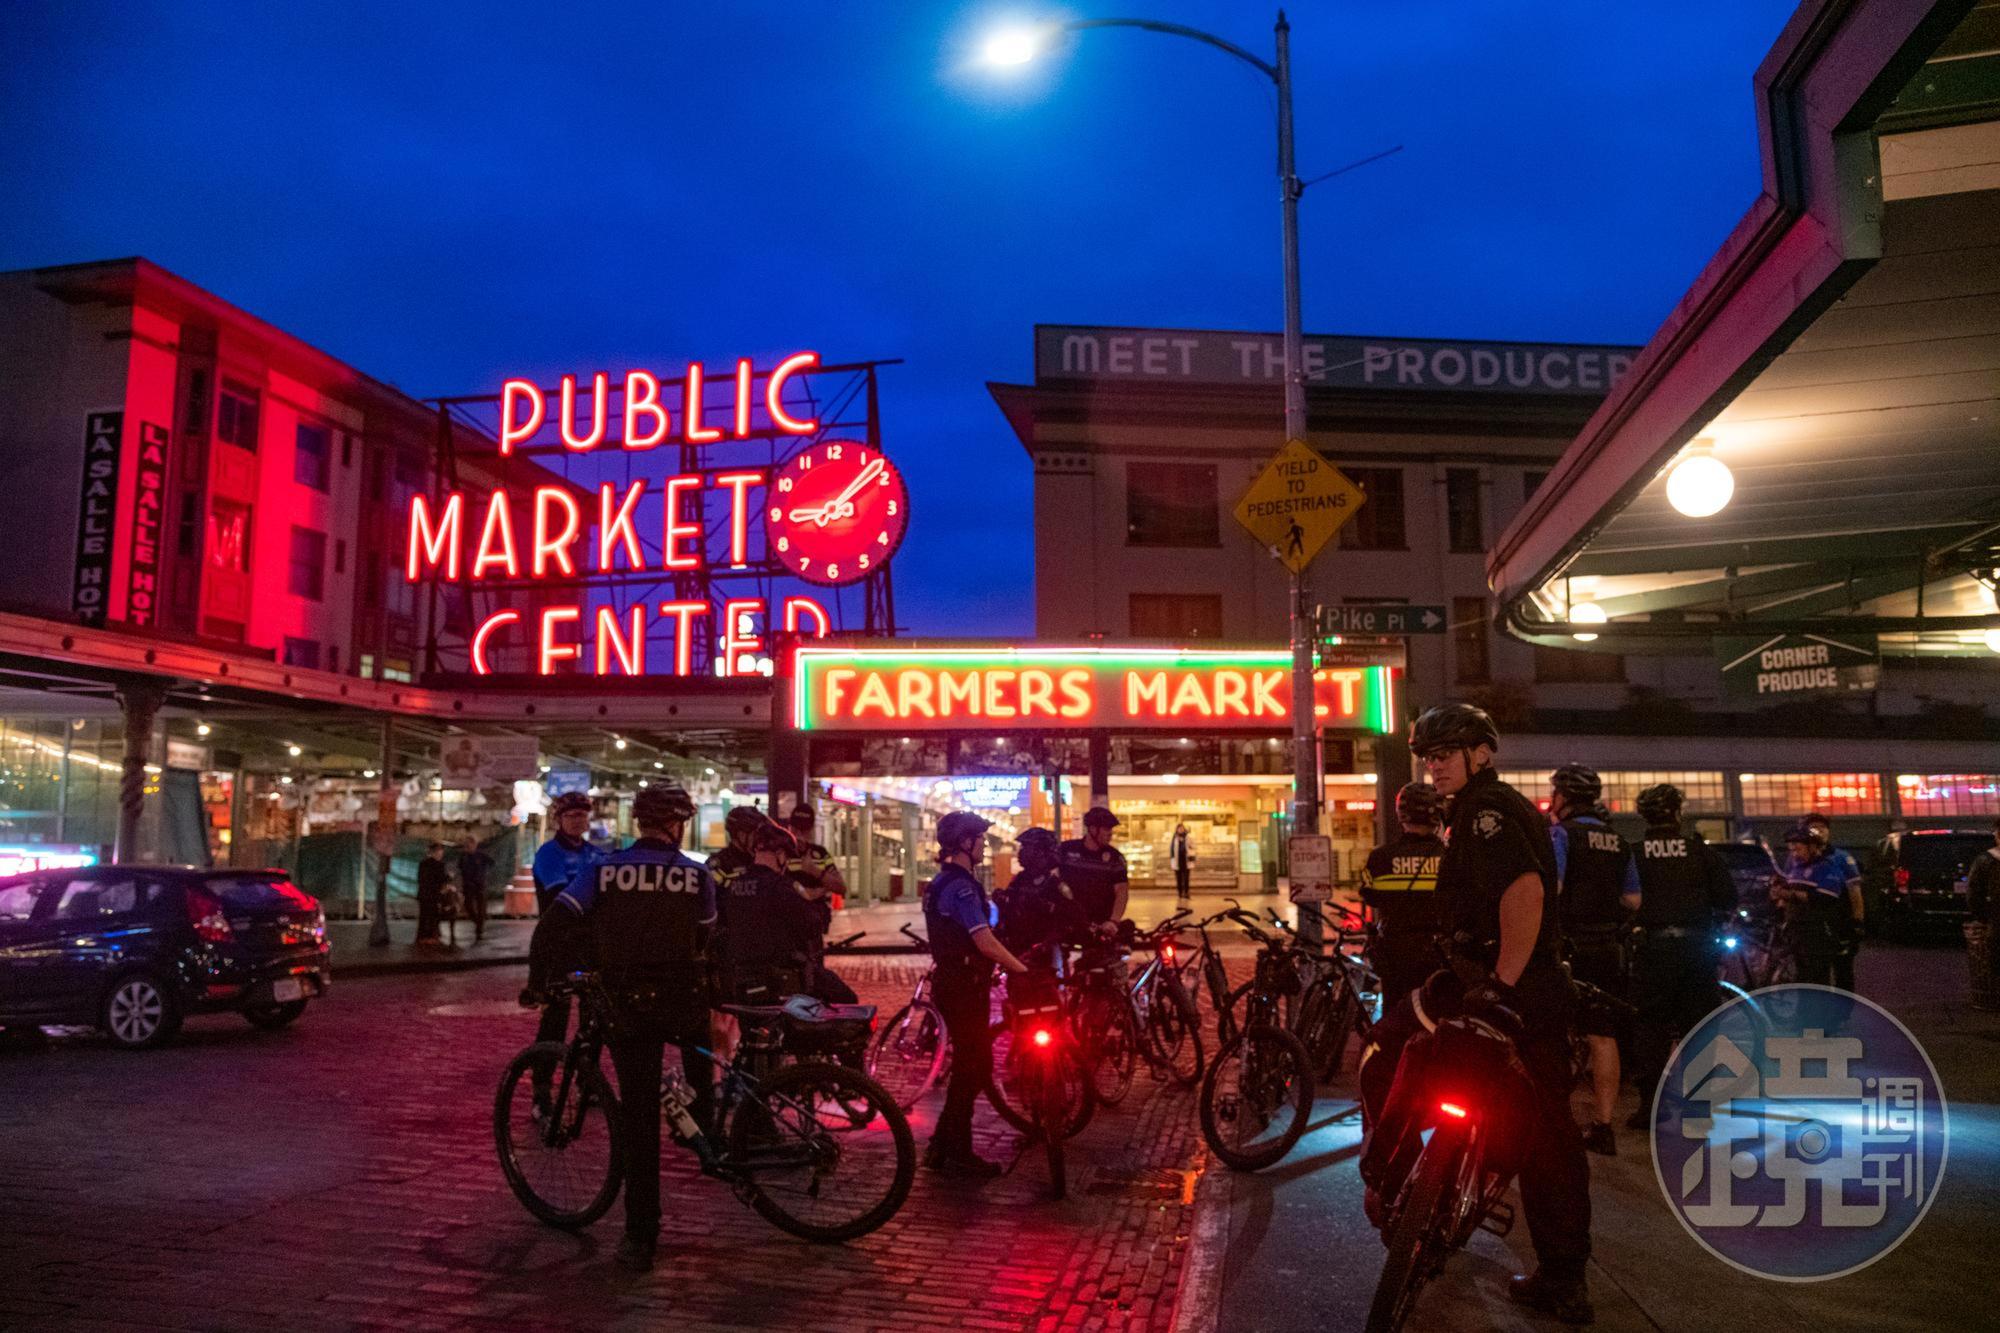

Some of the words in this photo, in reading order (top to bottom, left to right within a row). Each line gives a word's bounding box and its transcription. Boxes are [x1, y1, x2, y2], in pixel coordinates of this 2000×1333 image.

[1062, 335, 1199, 375] MEET
[500, 351, 818, 455] PUBLIC
[827, 445, 843, 460] 12
[860, 451, 867, 465] 1
[800, 456, 811, 470] 11
[1275, 460, 1318, 476] YIELD
[778, 477, 793, 492] 10
[879, 471, 890, 486] 2
[1286, 480, 1305, 493] TO
[887, 500, 897, 516] 3
[1247, 493, 1347, 517] PEDESTRIANS
[770, 508, 782, 522] 9
[404, 472, 766, 582] MARKET
[777, 537, 789, 552] 8
[877, 531, 889, 545] 4
[800, 557, 810, 571] 7
[859, 554, 870, 569] 5
[827, 563, 839, 579] 6
[1327, 608, 1375, 630] Pike
[1760, 645, 1829, 670] CORNER
[1757, 667, 1838, 693] PRODUCE
[825, 669, 1092, 717] FARMERS
[1588, 831, 1620, 852] POLICE
[1644, 839, 1688, 858] POLICE
[600, 864, 700, 894] POLICE
